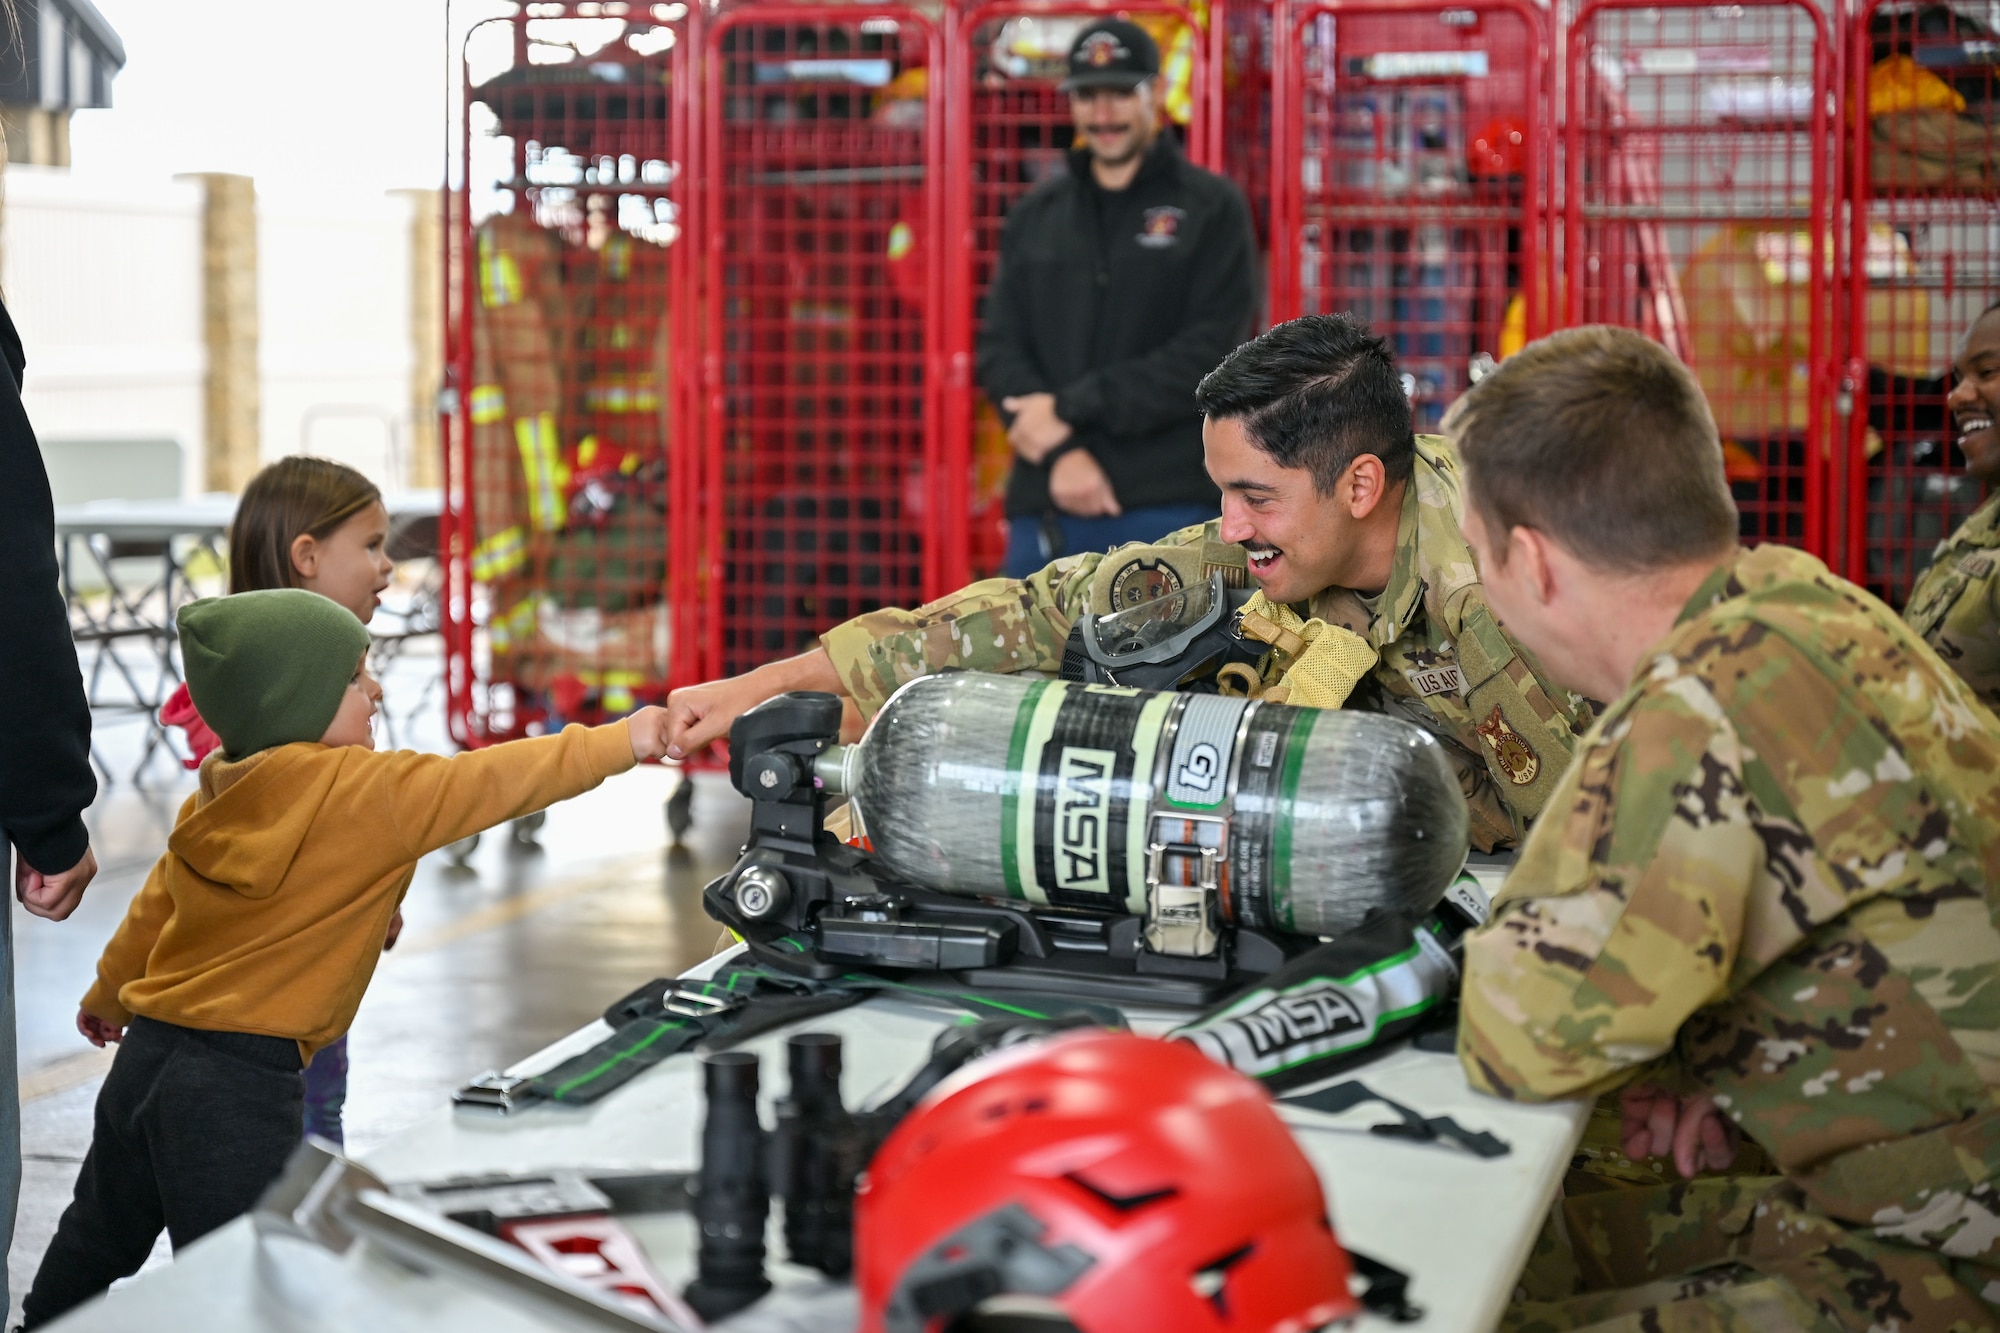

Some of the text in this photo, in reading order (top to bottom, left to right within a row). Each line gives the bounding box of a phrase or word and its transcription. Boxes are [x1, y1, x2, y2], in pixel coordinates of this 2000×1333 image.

[1417, 674, 1442, 693] U.S.
[1518, 763, 1535, 782] USAF
[1062, 757, 1105, 885] MSA
[1250, 989, 1361, 1052] MSA
